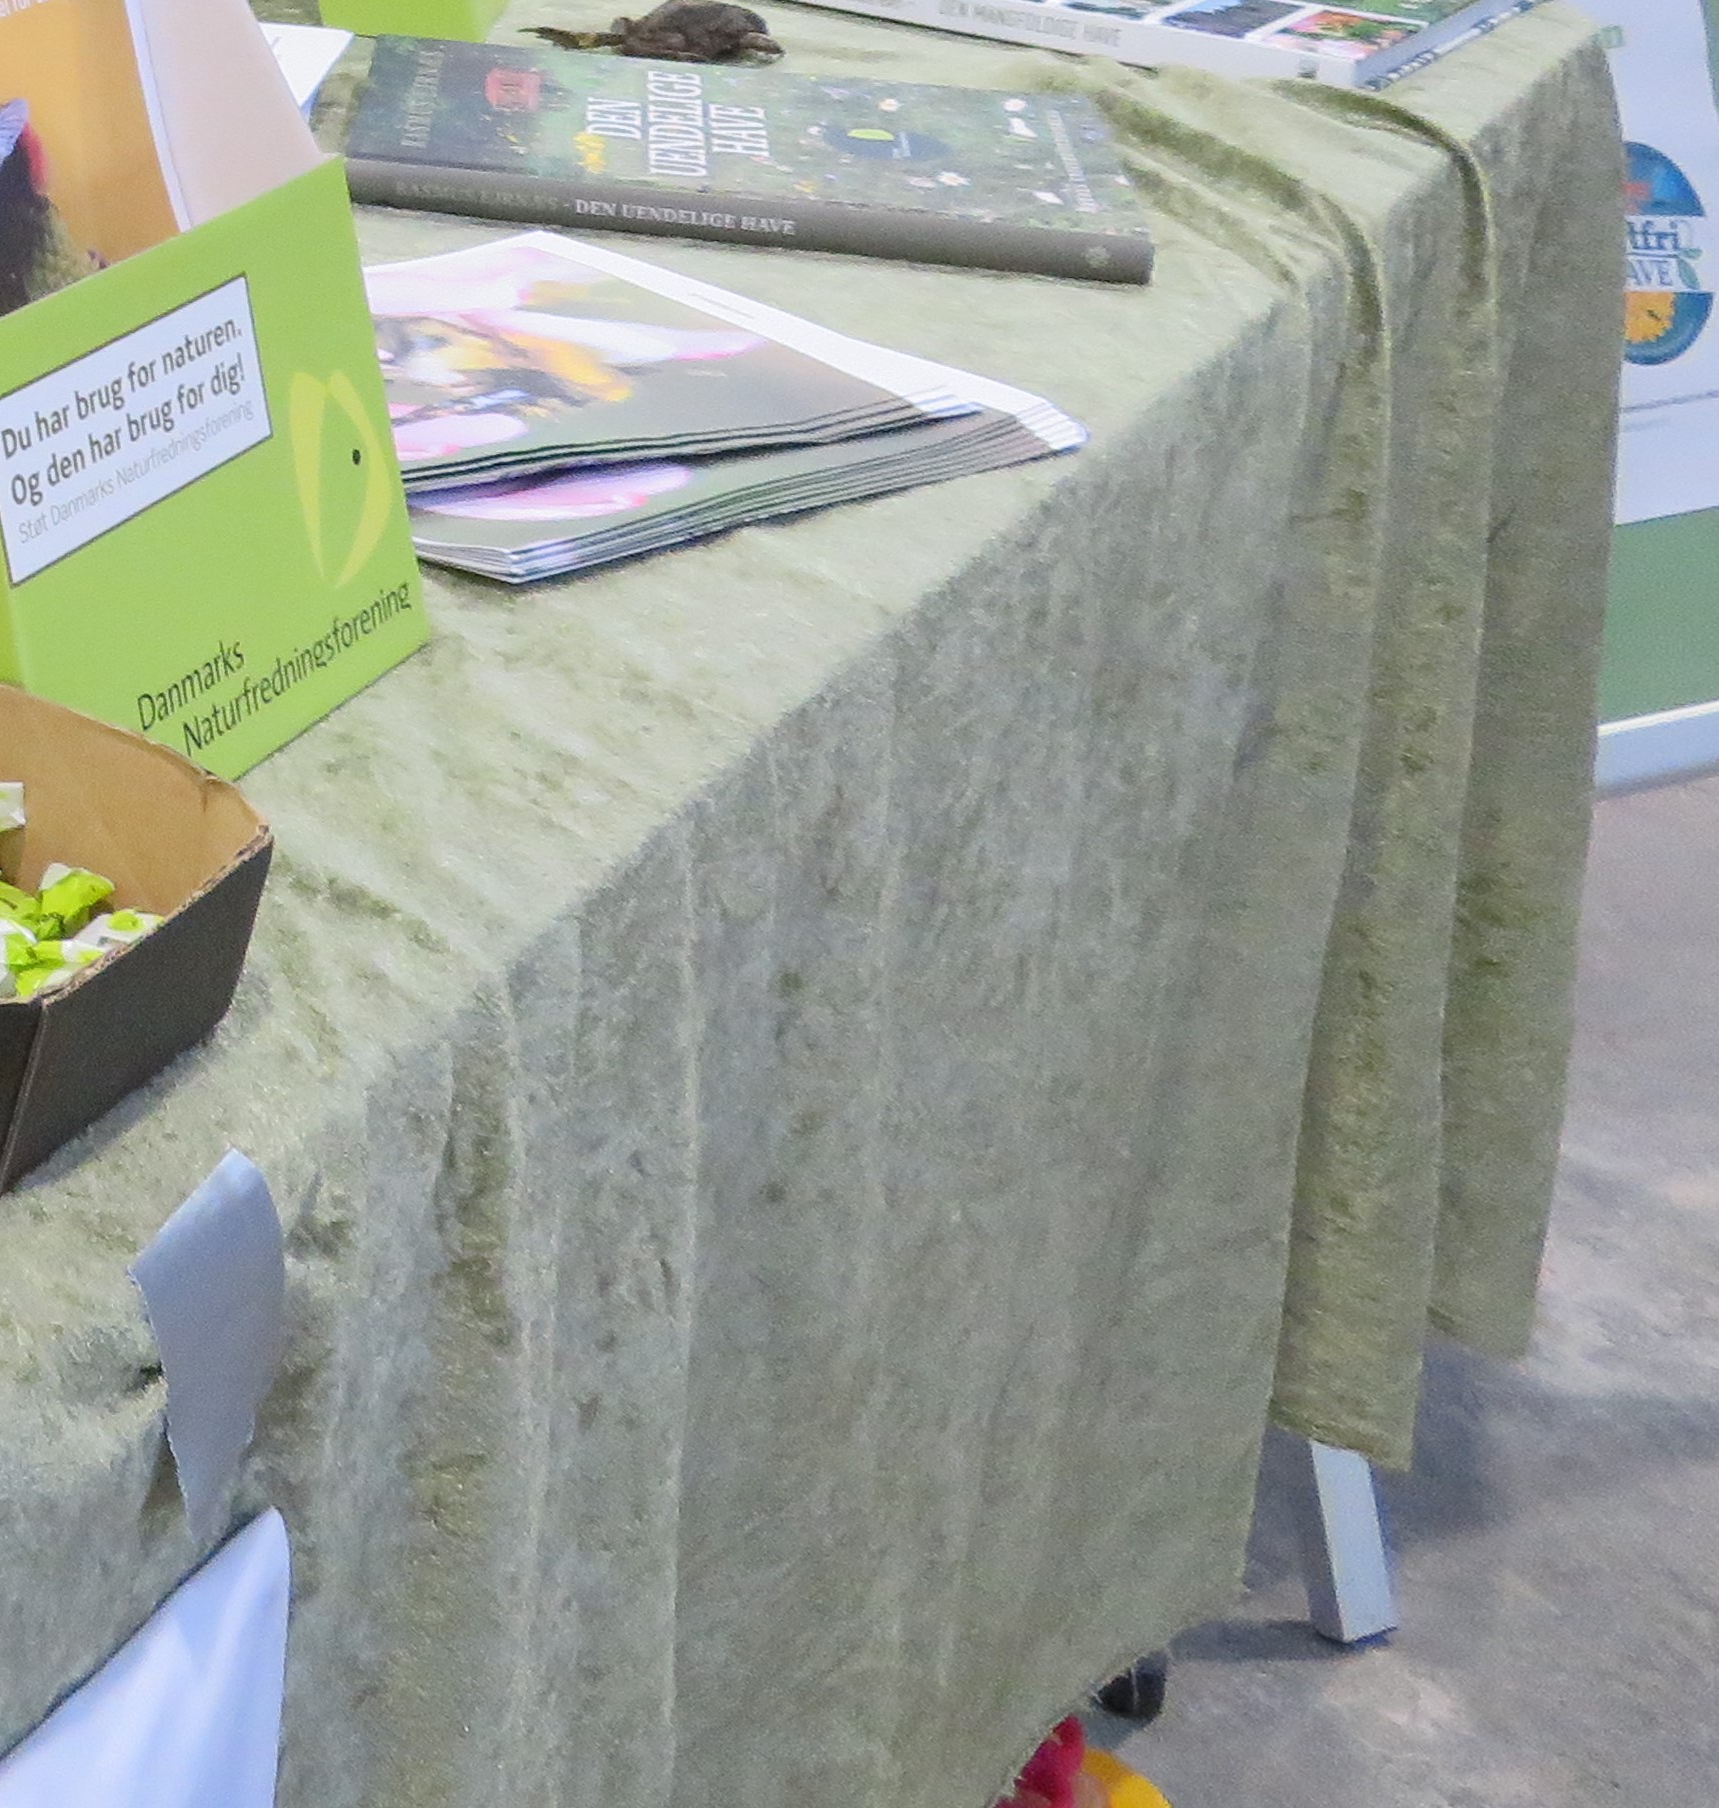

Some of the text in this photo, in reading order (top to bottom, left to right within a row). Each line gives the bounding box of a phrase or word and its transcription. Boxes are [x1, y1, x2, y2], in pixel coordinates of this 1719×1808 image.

[585, 96, 643, 141] DEN
[646, 69, 708, 178] UENDELIGE
[708, 103, 771, 158] HAVE
[574, 198, 617, 217] DEN
[620, 203, 737, 230] UENDELIGE
[739, 215, 796, 236] HAVE
[0, 318, 243, 460] Du har brug for naturen.
[11, 352, 246, 507] Og den har brug for dig!
[18, 400, 255, 544] Støt Danmarks Naturfredningsforening
[137, 639, 246, 733] Danmarks
[181, 580, 413, 758] Naturfredningsforening
